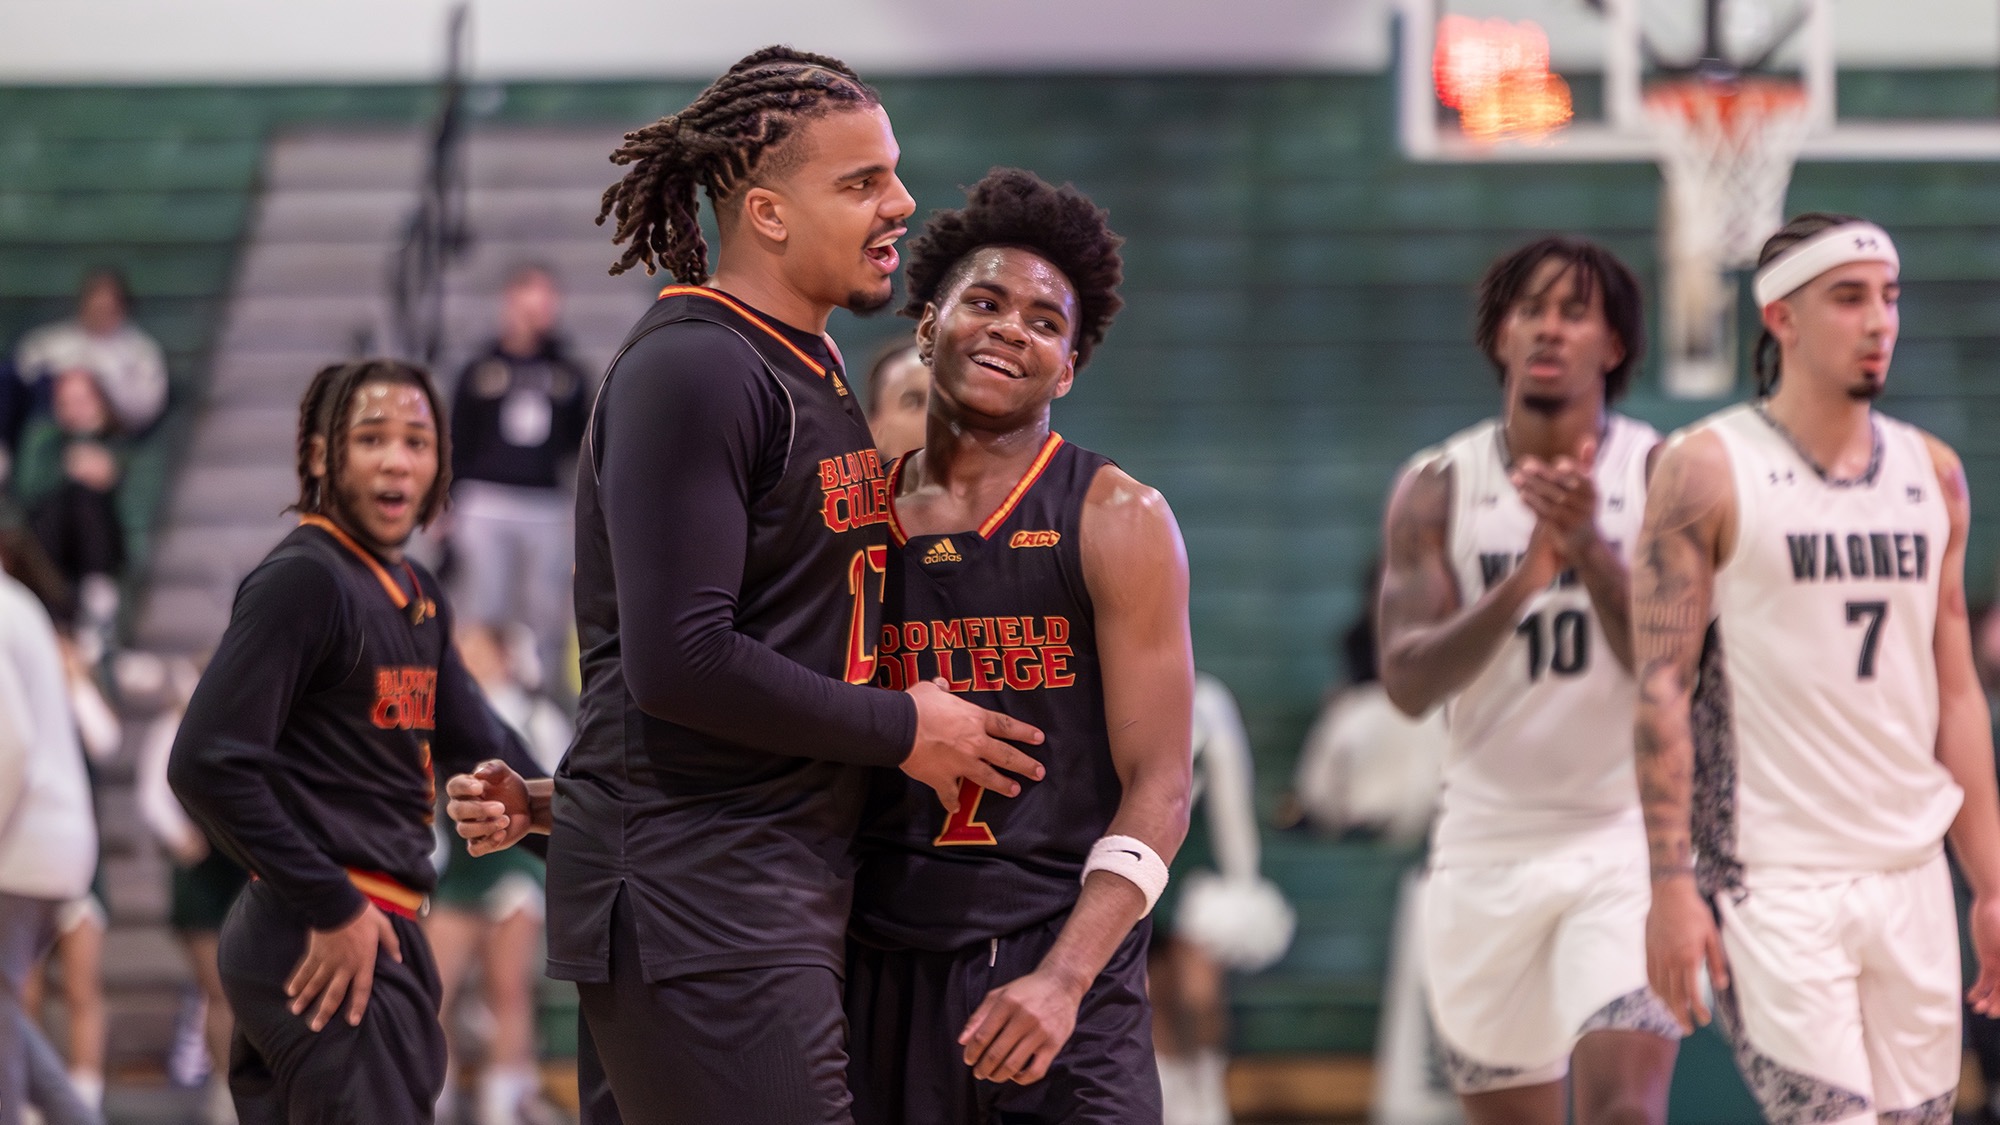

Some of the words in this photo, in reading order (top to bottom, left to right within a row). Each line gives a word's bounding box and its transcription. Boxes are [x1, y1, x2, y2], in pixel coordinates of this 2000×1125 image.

[820, 479, 889, 533] COLLE
[923, 554, 963, 565] adidas
[1011, 531, 1060, 547] CACC
[881, 616, 1070, 653] OOMFIELD
[1517, 609, 1588, 684] 10
[1844, 600, 1887, 679] 7
[878, 645, 1076, 692] OLLEGE
